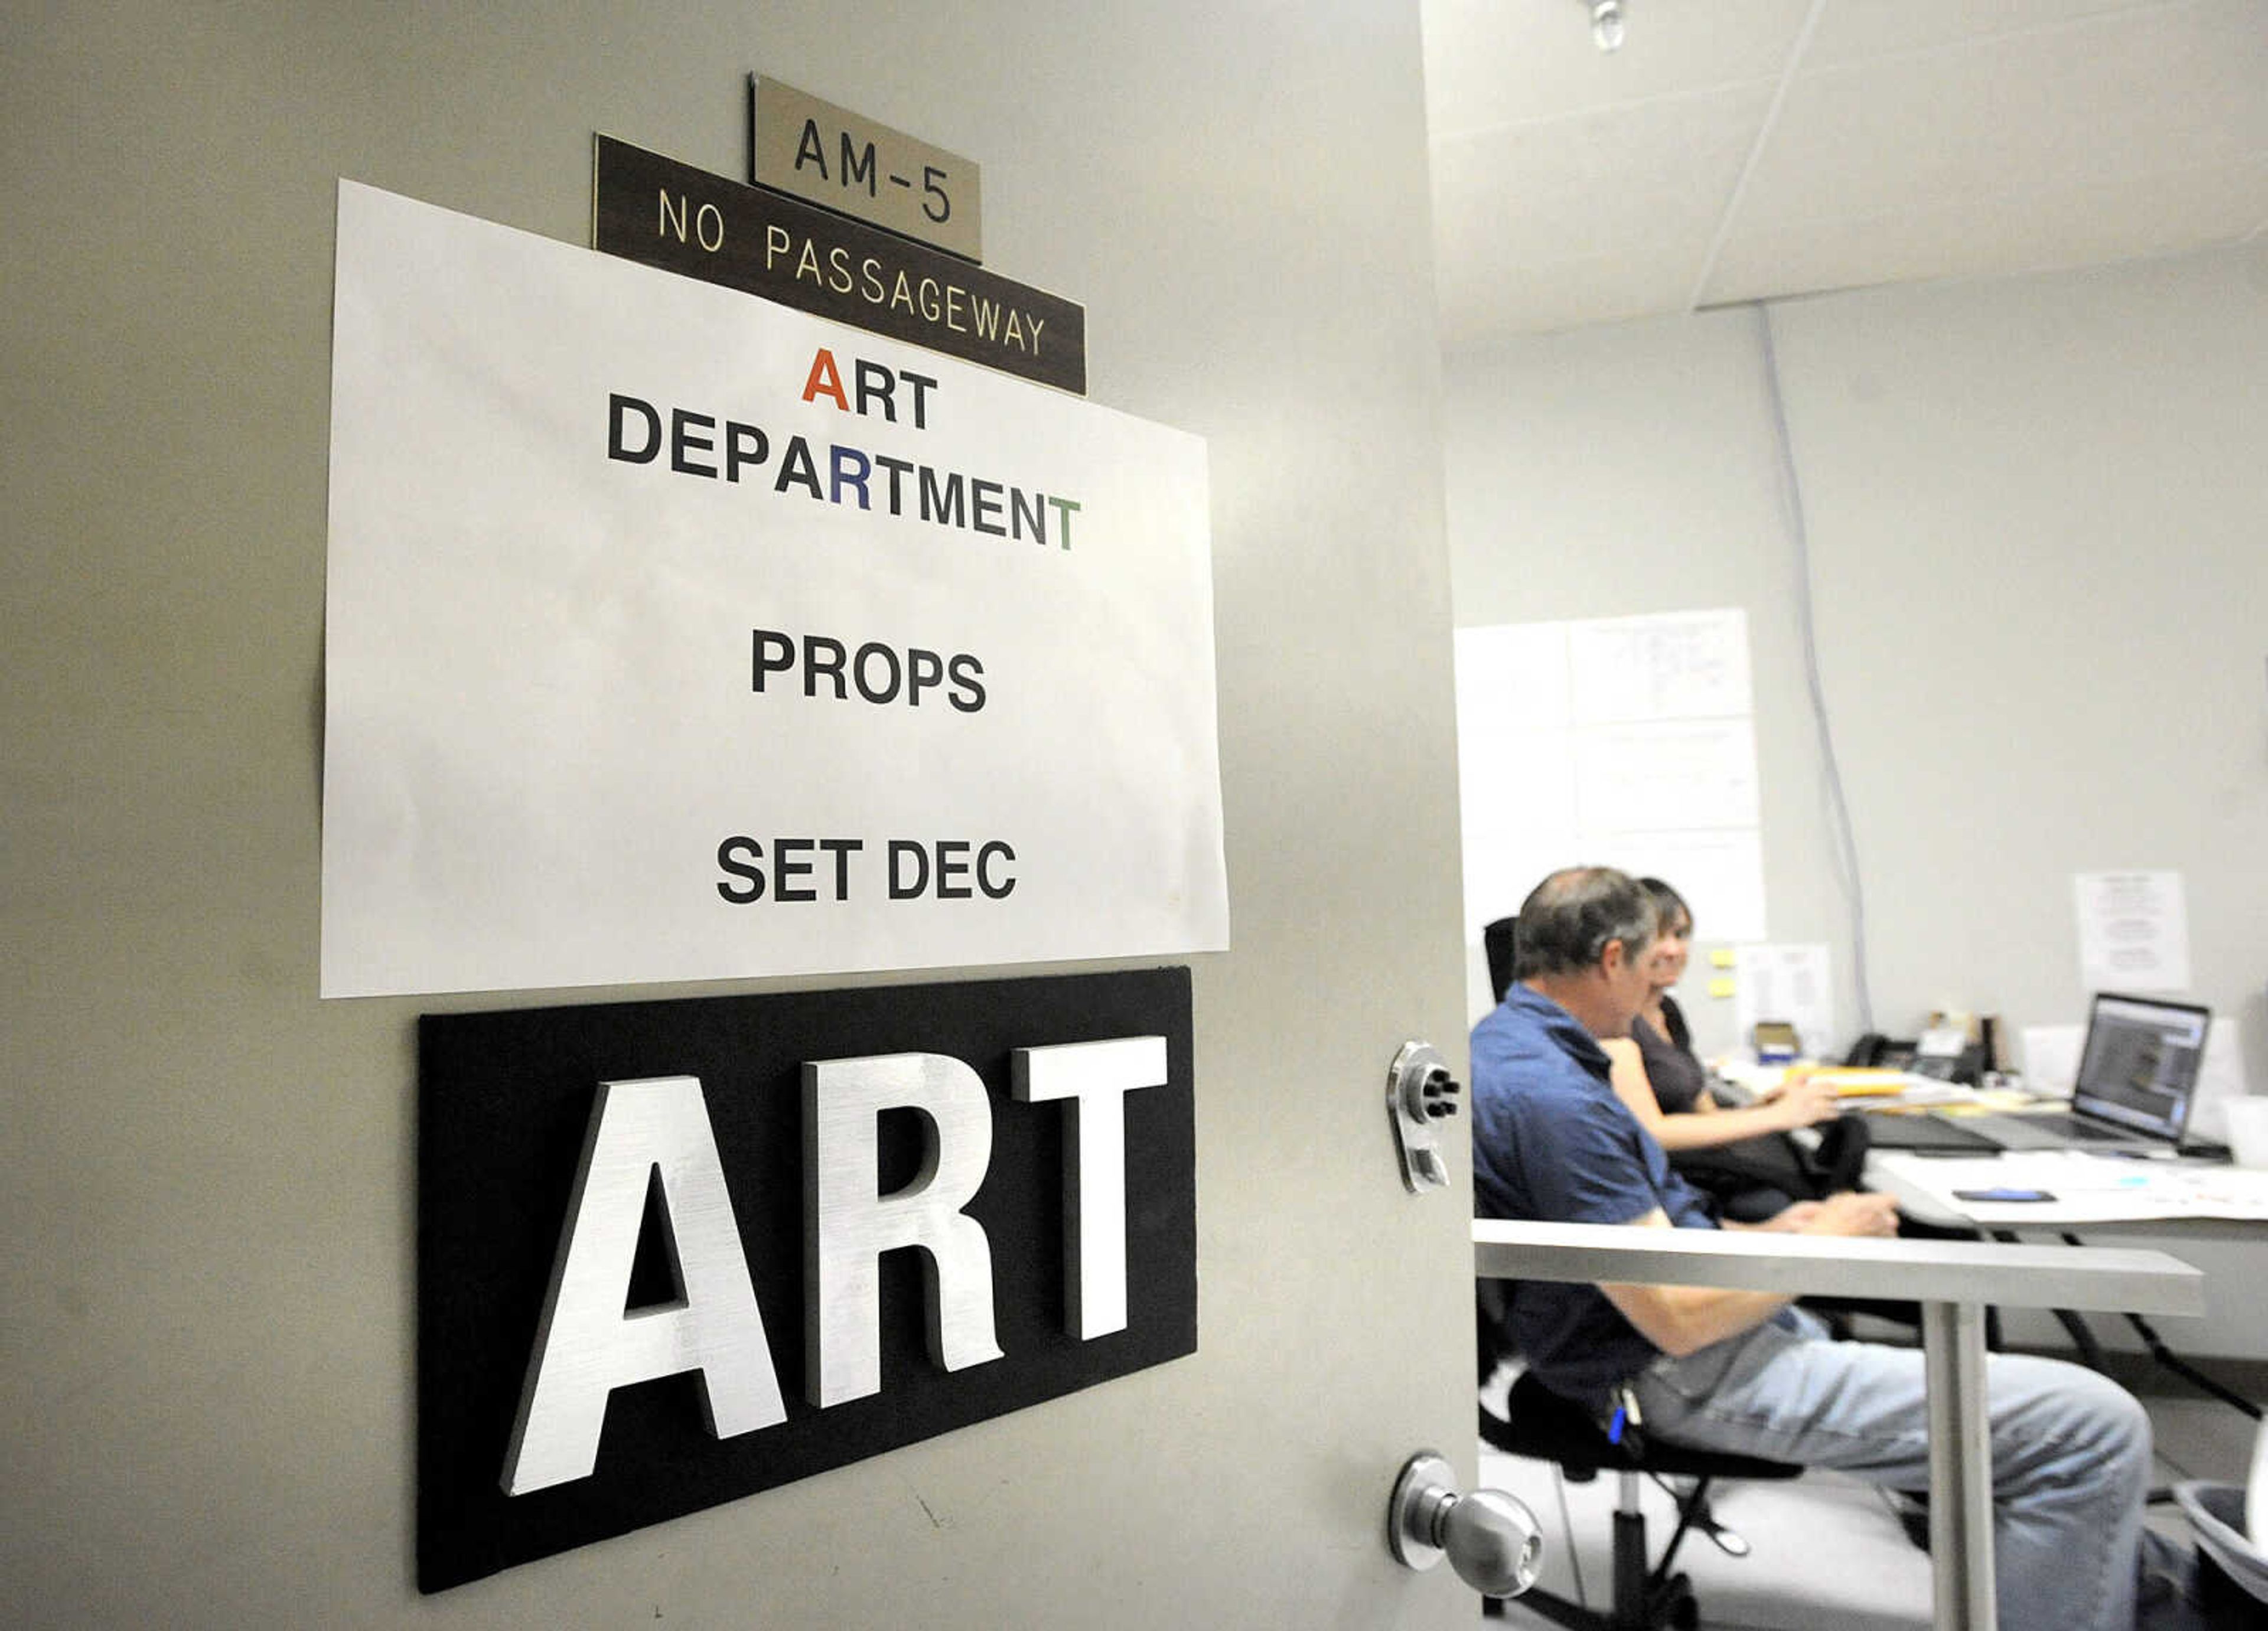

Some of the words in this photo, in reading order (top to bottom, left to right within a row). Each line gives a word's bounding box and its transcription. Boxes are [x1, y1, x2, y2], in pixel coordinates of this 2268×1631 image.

[794, 119, 951, 223] AM-5
[659, 188, 725, 252] NO
[767, 225, 1045, 356] PASSAGEWAY
[802, 348, 938, 429] ART
[608, 393, 1081, 550] DEPARTMENT
[752, 629, 986, 713] PROPS
[717, 836, 863, 904] SET
[888, 840, 1016, 900] DEC
[499, 1035, 1168, 1497] ART
